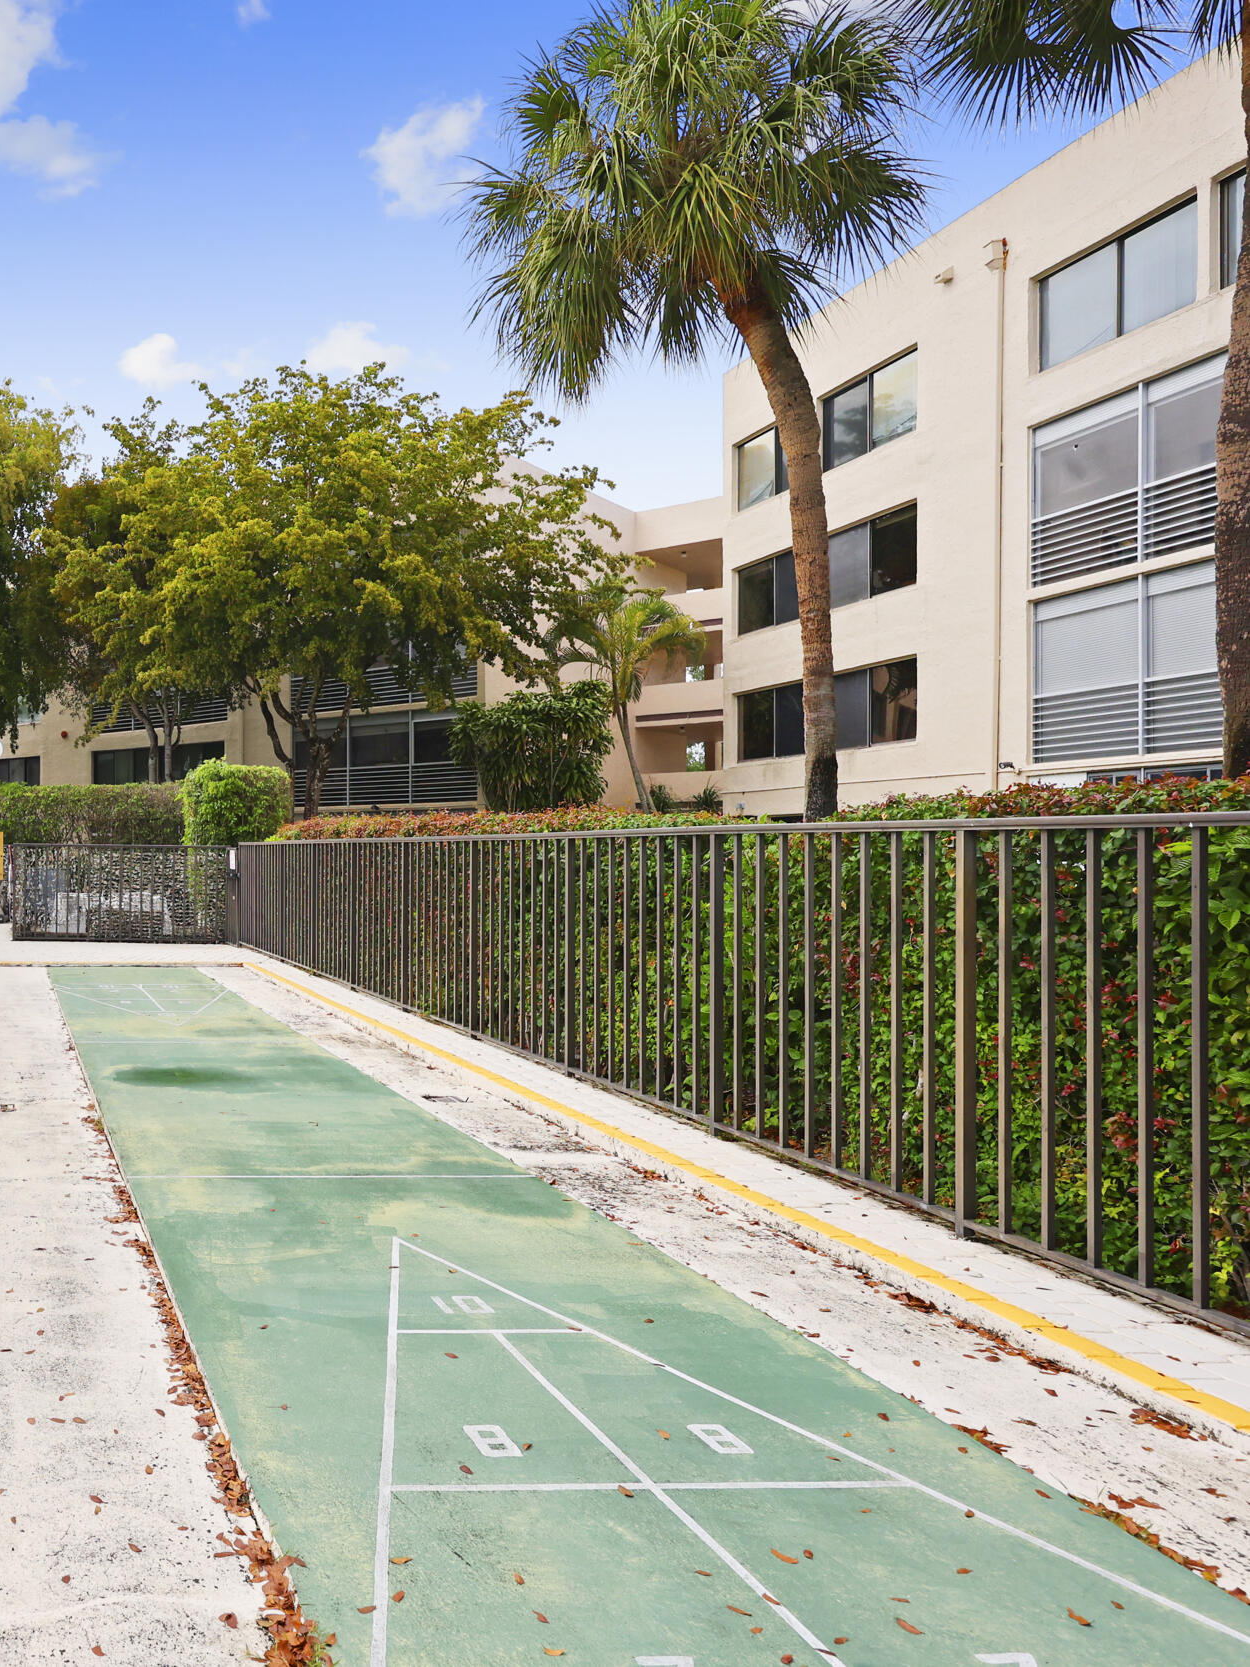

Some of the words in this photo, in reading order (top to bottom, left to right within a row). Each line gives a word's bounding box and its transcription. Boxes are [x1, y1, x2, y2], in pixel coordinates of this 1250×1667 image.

[430, 1296, 495, 1314] 10
[462, 1424, 523, 1457] 8
[686, 1424, 754, 1453] 8
